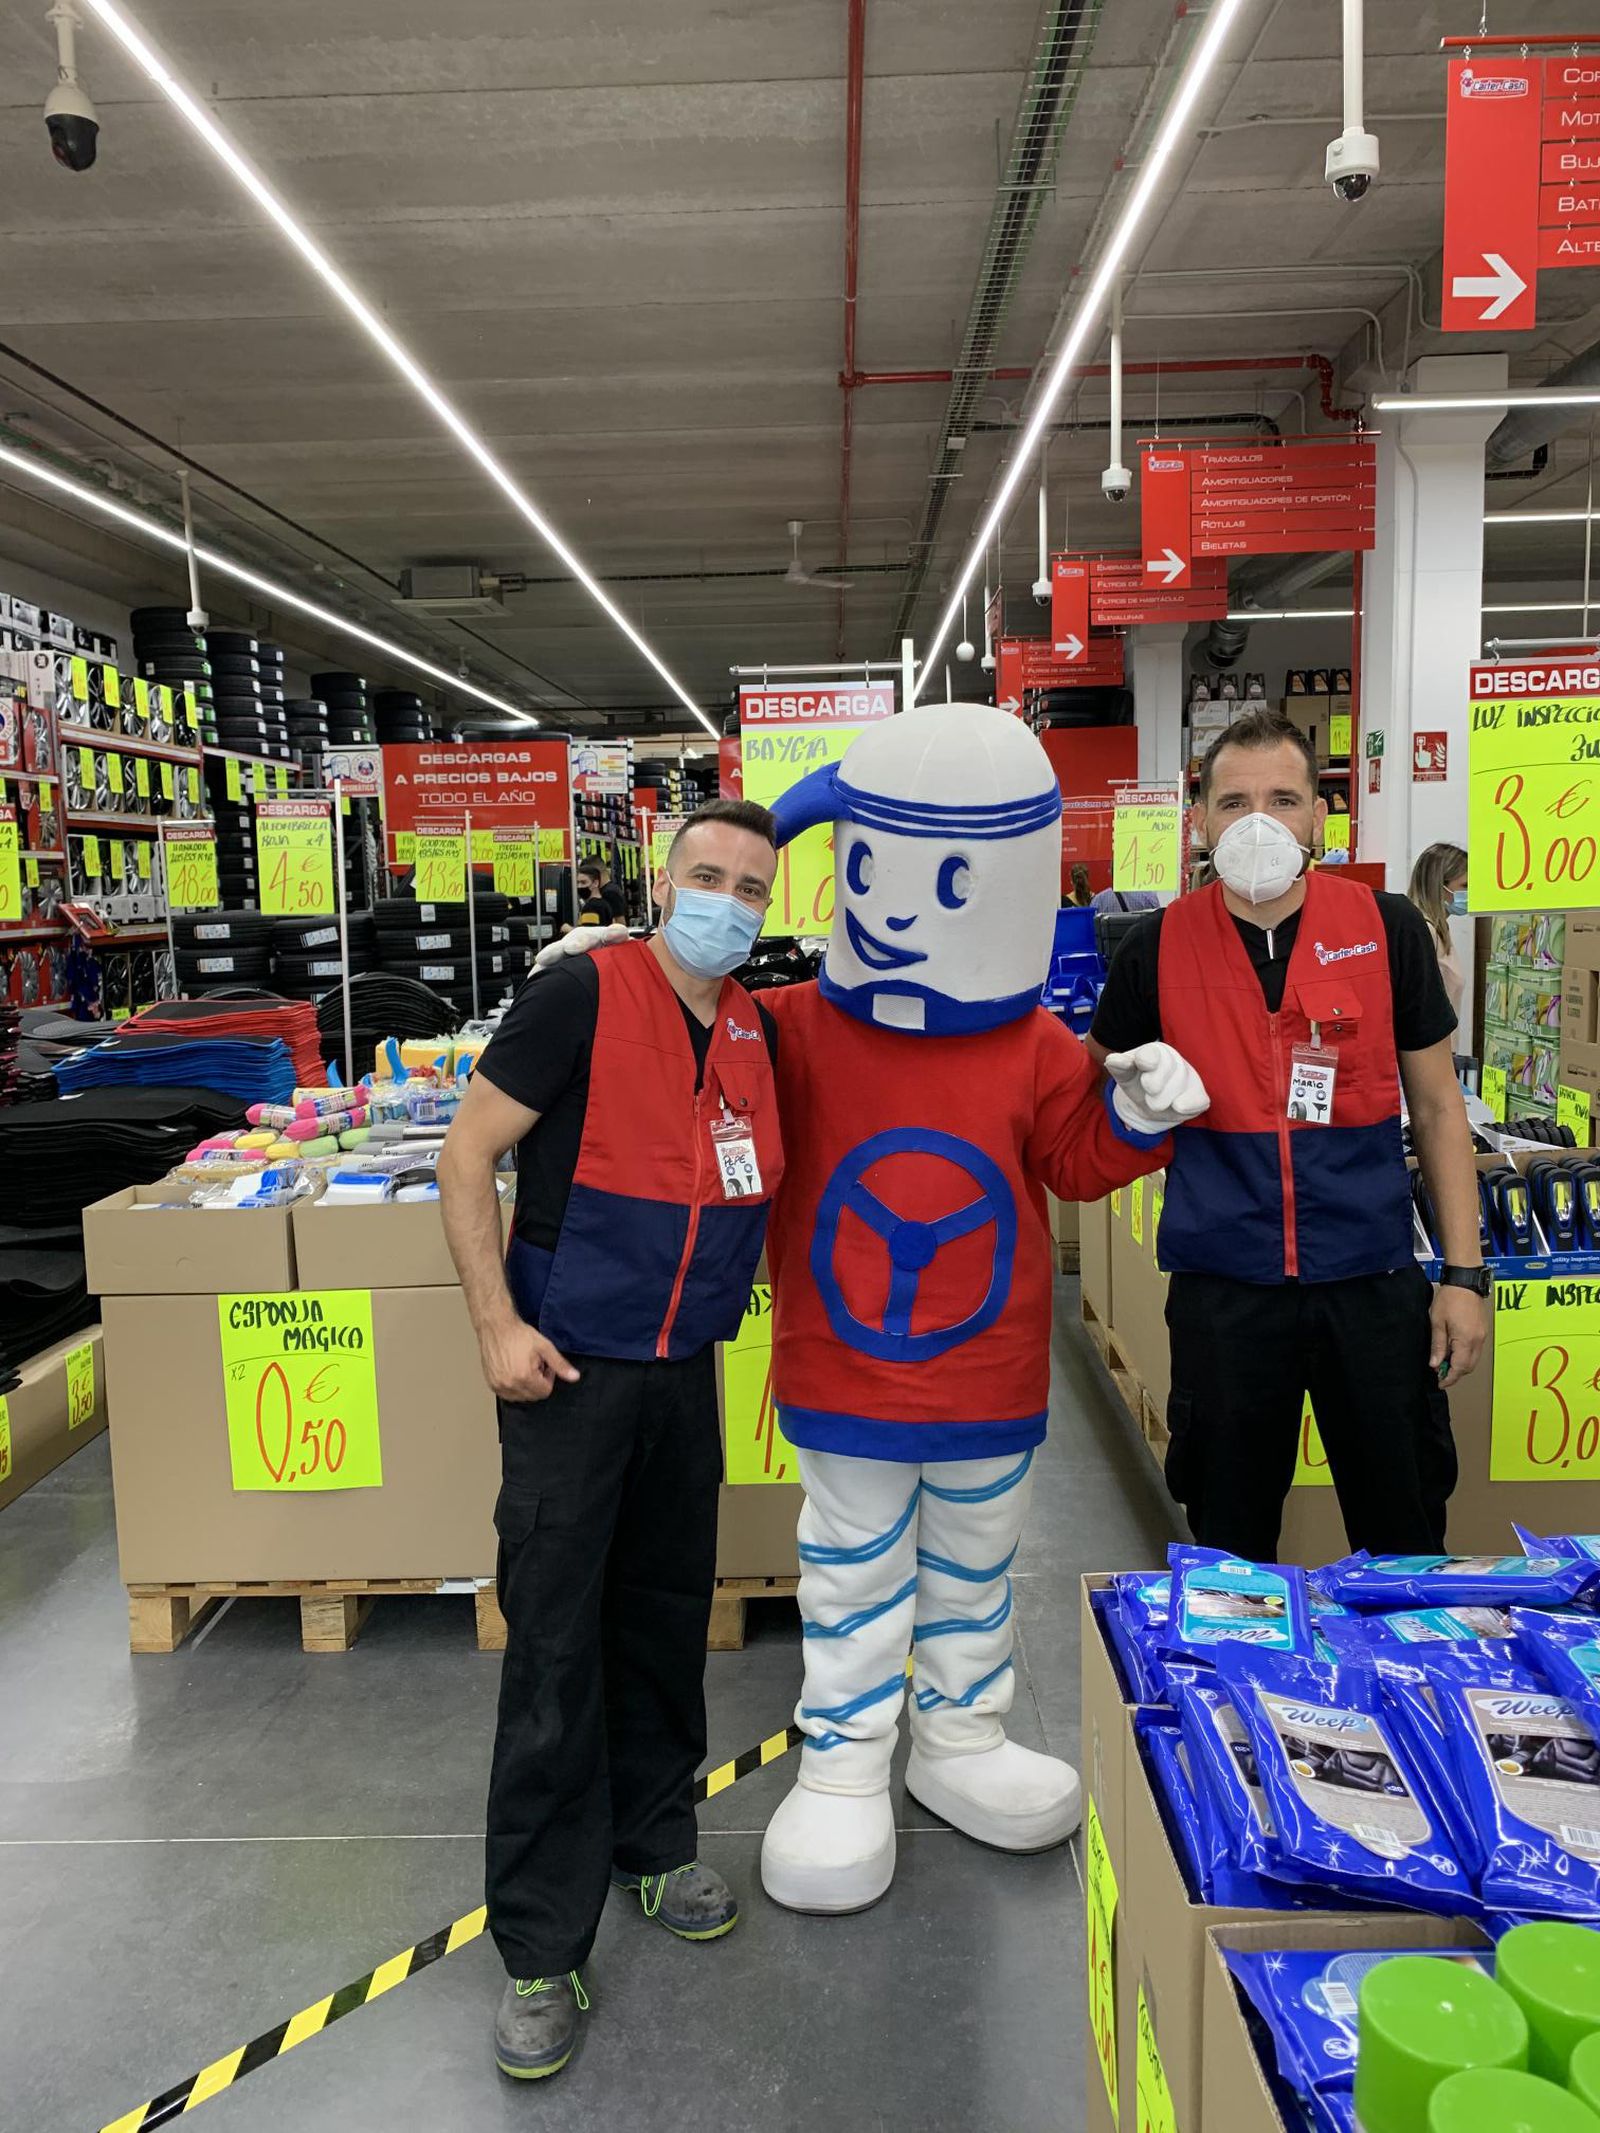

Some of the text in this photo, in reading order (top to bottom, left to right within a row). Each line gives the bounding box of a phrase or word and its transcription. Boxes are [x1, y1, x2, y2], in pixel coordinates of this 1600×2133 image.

[746, 695, 888, 719] DESCARGA
[1473, 704, 1506, 731] LUZ
[419, 752, 531, 765] DESCARGAS
[394, 771, 558, 785] A PRECIOS BAJOS
[418, 789, 535, 804] TODO EL AÑO
[1117, 793, 1177, 803] DESCARGA
[259, 804, 327, 815] DESCARGA
[166, 831, 212, 839] DESCARGA
[416, 827, 462, 835] DESCARGA
[1293, 1079, 1324, 1089] MARIO
[1497, 1283, 1533, 1311] LUZ
[229, 1299, 324, 1330] ESPONJA
[283, 1324, 364, 1352] MÁGICA
[303, 1363, 341, 1404] €
[256, 1361, 347, 1483] 0,50
[1282, 1706, 1358, 1732] Weep
[1492, 1700, 1576, 1719] Weep
